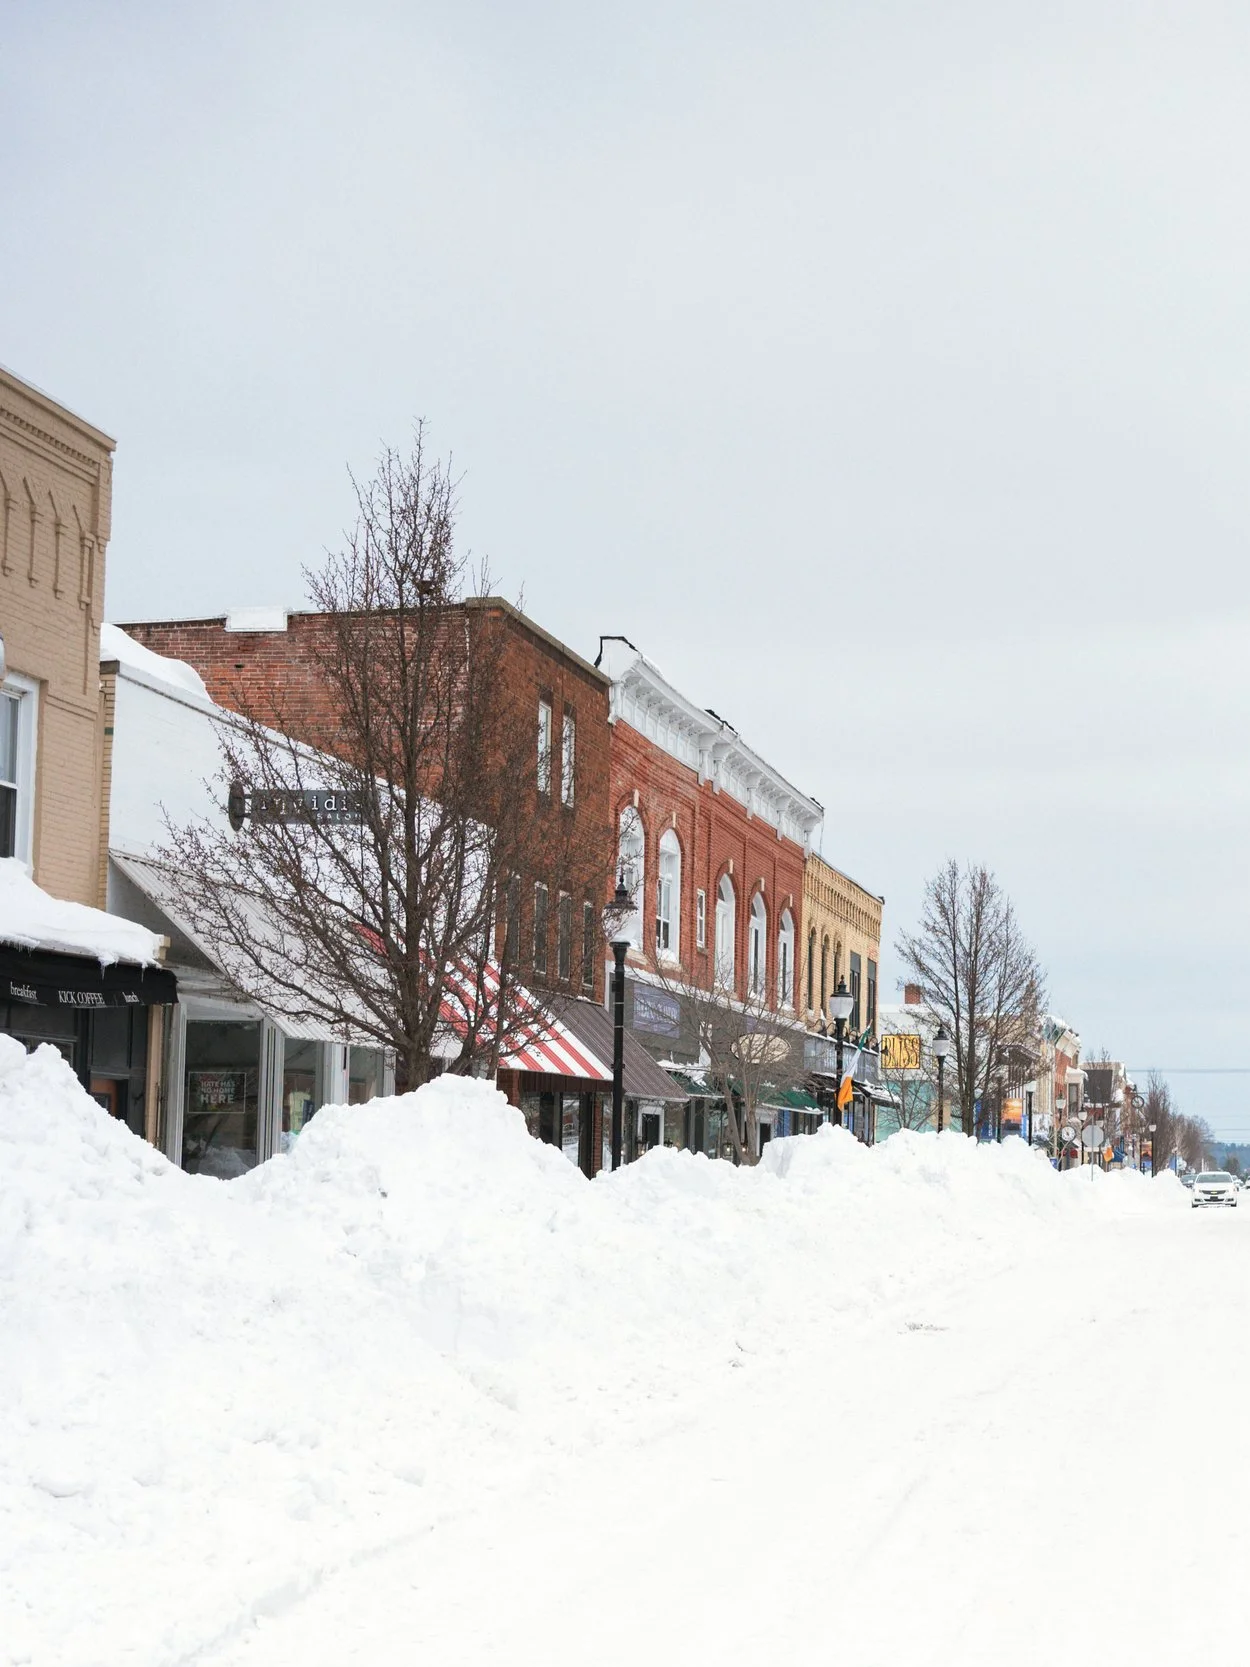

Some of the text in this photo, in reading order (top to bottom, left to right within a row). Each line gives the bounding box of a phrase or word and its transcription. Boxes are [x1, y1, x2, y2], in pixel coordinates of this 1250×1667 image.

[10, 981, 38, 1000] breakfast
[58, 990, 105, 1005] KICK COFFEE
[122, 992, 140, 1003] lunch
[200, 1094, 235, 1104] HERE
